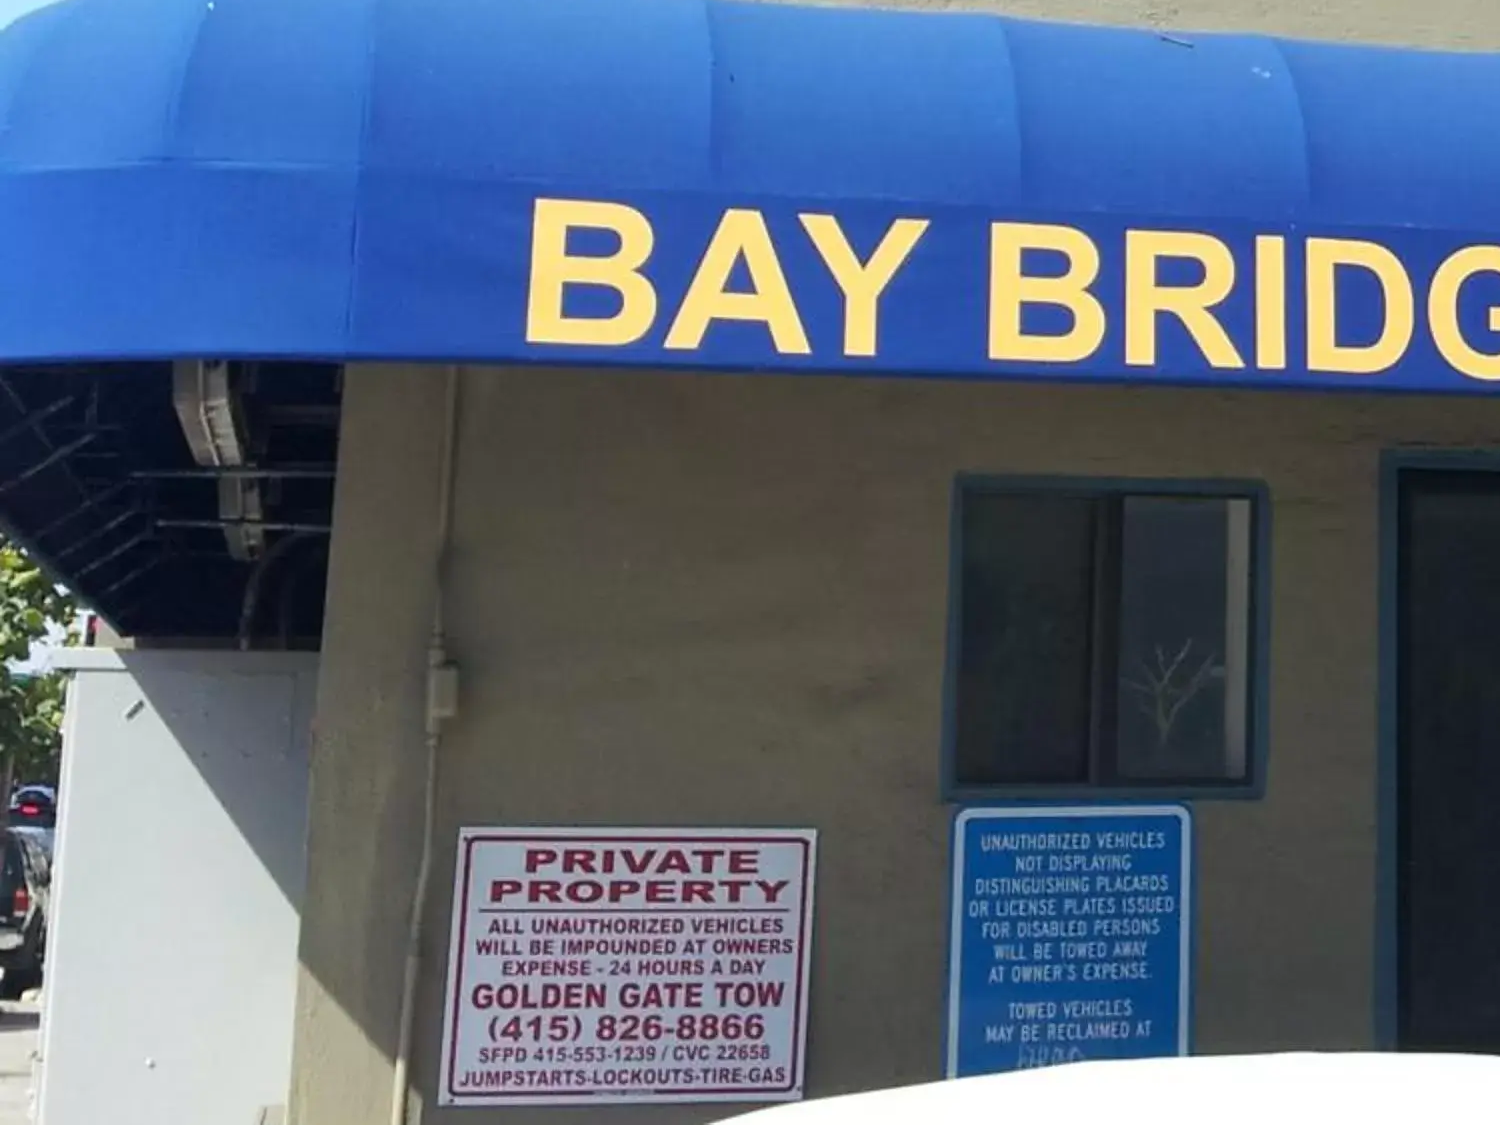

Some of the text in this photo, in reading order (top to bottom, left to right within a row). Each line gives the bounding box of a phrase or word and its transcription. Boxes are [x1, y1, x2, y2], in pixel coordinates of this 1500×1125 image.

[525, 197, 931, 357] BAY
[981, 832, 1165, 851] UNAUTHORIZED VEHICLES
[525, 849, 760, 874] PRIVATE
[1015, 854, 1132, 872] NOT DISPLAYING
[489, 880, 790, 904] PROPERTY
[975, 876, 1169, 895] DISTINGUISHING PLACARDS
[969, 896, 1175, 917] OR LICENSE PLATES ISSUED
[488, 919, 784, 935] ALL UNAUTHORIZED VEHICLES
[981, 919, 1160, 940] FOR DISABLED PERSONS
[476, 939, 794, 955] WILL BE IMPOUNDED AT OWNERS
[993, 941, 1148, 961] WILL BE TOWED AWAY
[502, 961, 591, 976] EXPENSE
[609, 961, 631, 976] 24
[638, 961, 705, 976] HOURS
[710, 961, 724, 975] A
[730, 961, 766, 975] DAY
[988, 967, 1005, 984] AT
[1012, 965, 1076, 983] OWNER'S
[471, 982, 785, 1010] GOLDEN GATE TOW
[1008, 999, 1132, 1020] TOWED VEHICLES
[488, 1014, 765, 1042] (415) 826-8866
[985, 1021, 1152, 1044] MAY BE RECLAIMED AT
[479, 1045, 770, 1063] SFPD 415-553-1239 / CVC 22658
